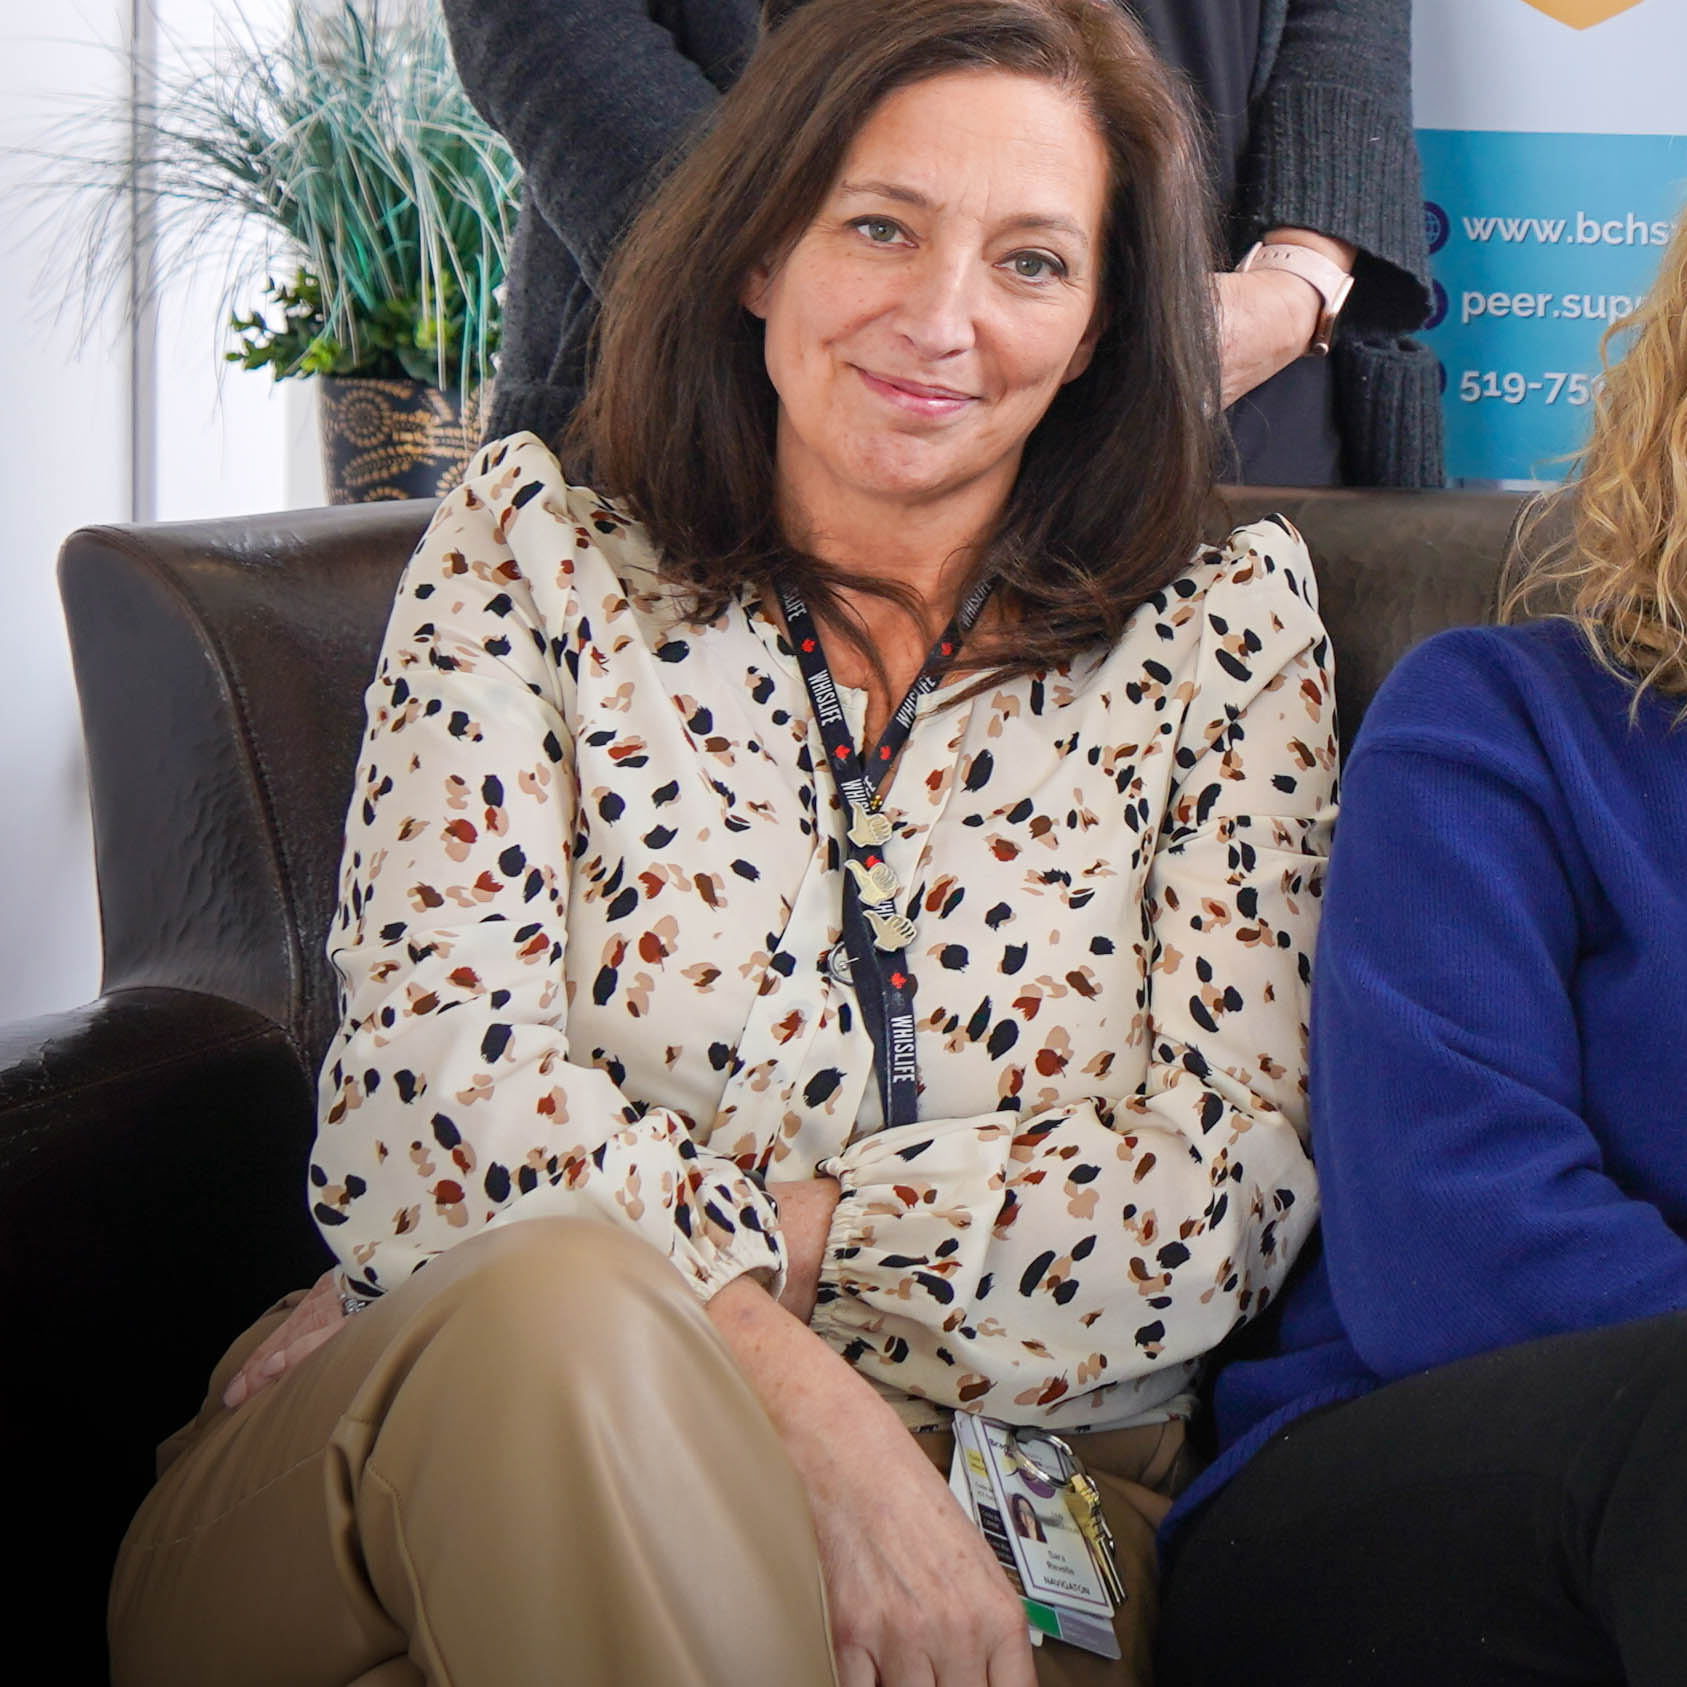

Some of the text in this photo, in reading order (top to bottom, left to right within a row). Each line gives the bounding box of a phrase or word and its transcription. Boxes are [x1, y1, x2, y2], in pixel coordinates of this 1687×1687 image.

[1462, 211, 1678, 246] www.bchs
[1461, 291, 1649, 324] peer.sup
[808, 669, 842, 727] WHISLIFE
[891, 1014, 915, 1084] WHISLIFE
